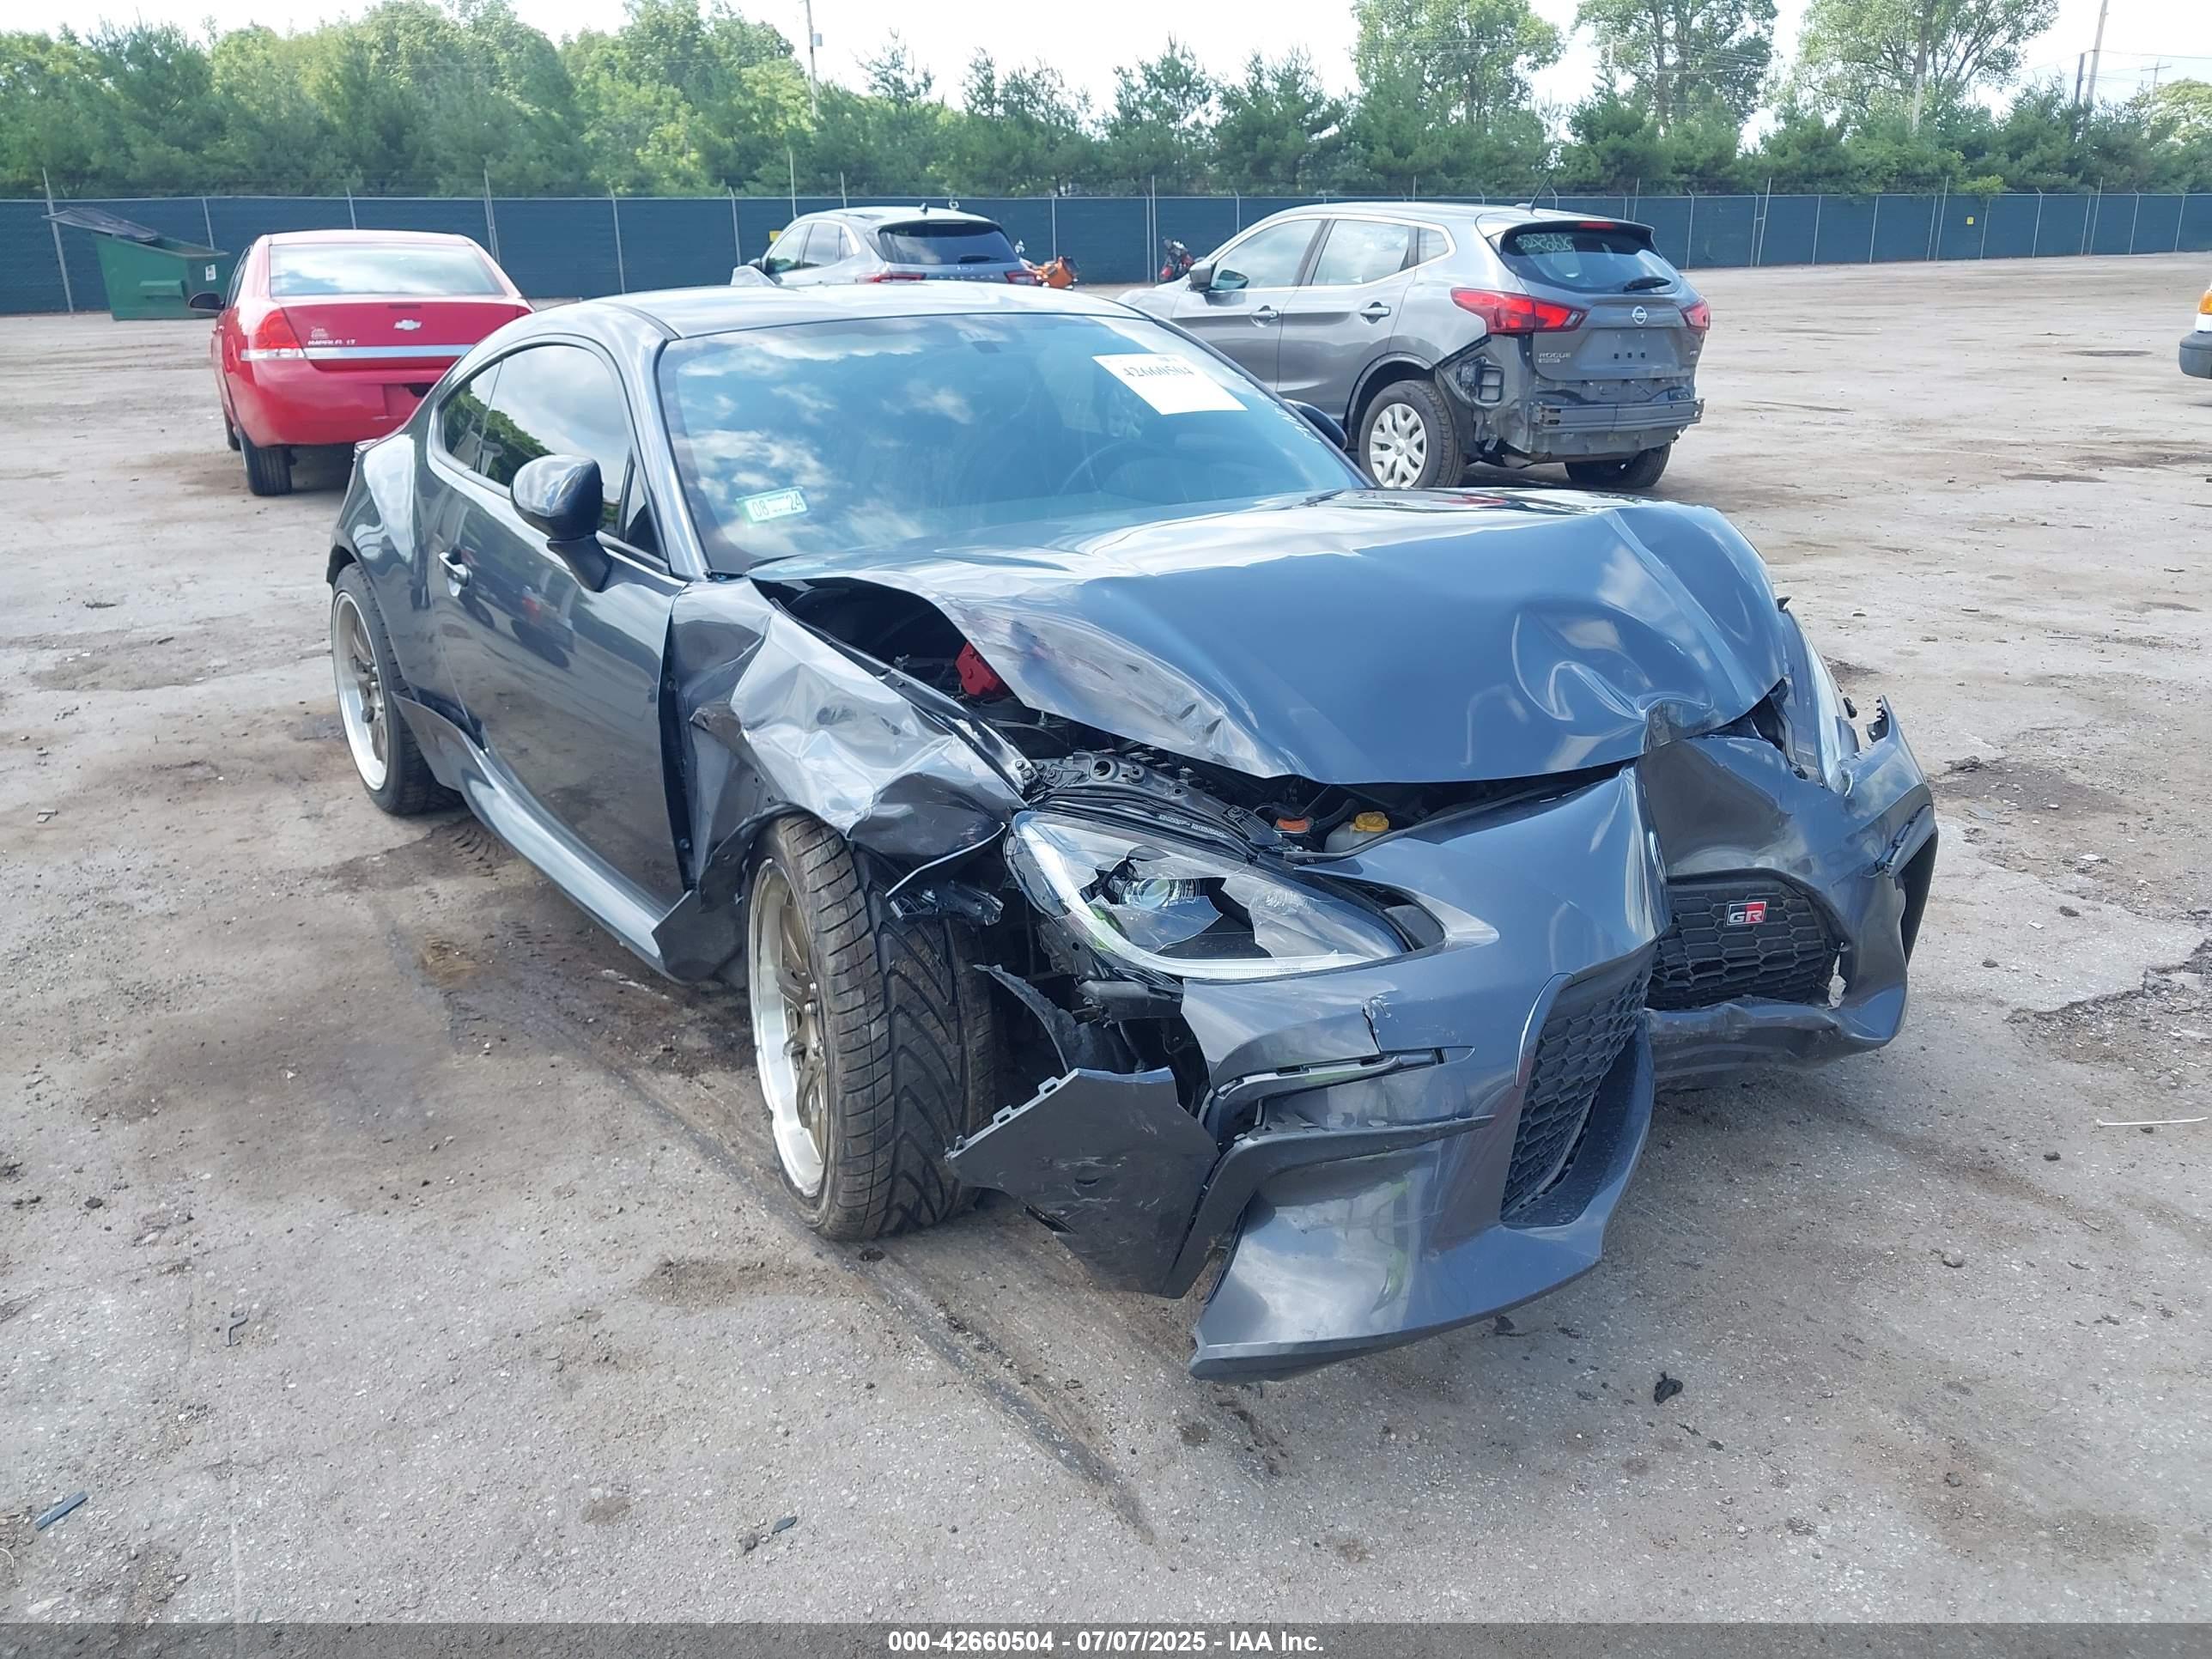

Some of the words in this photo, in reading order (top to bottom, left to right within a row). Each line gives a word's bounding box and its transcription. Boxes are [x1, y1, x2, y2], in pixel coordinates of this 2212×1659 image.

[752, 501, 769, 517] 08
[786, 492, 804, 511] 24
[1729, 910, 1763, 923] GR
